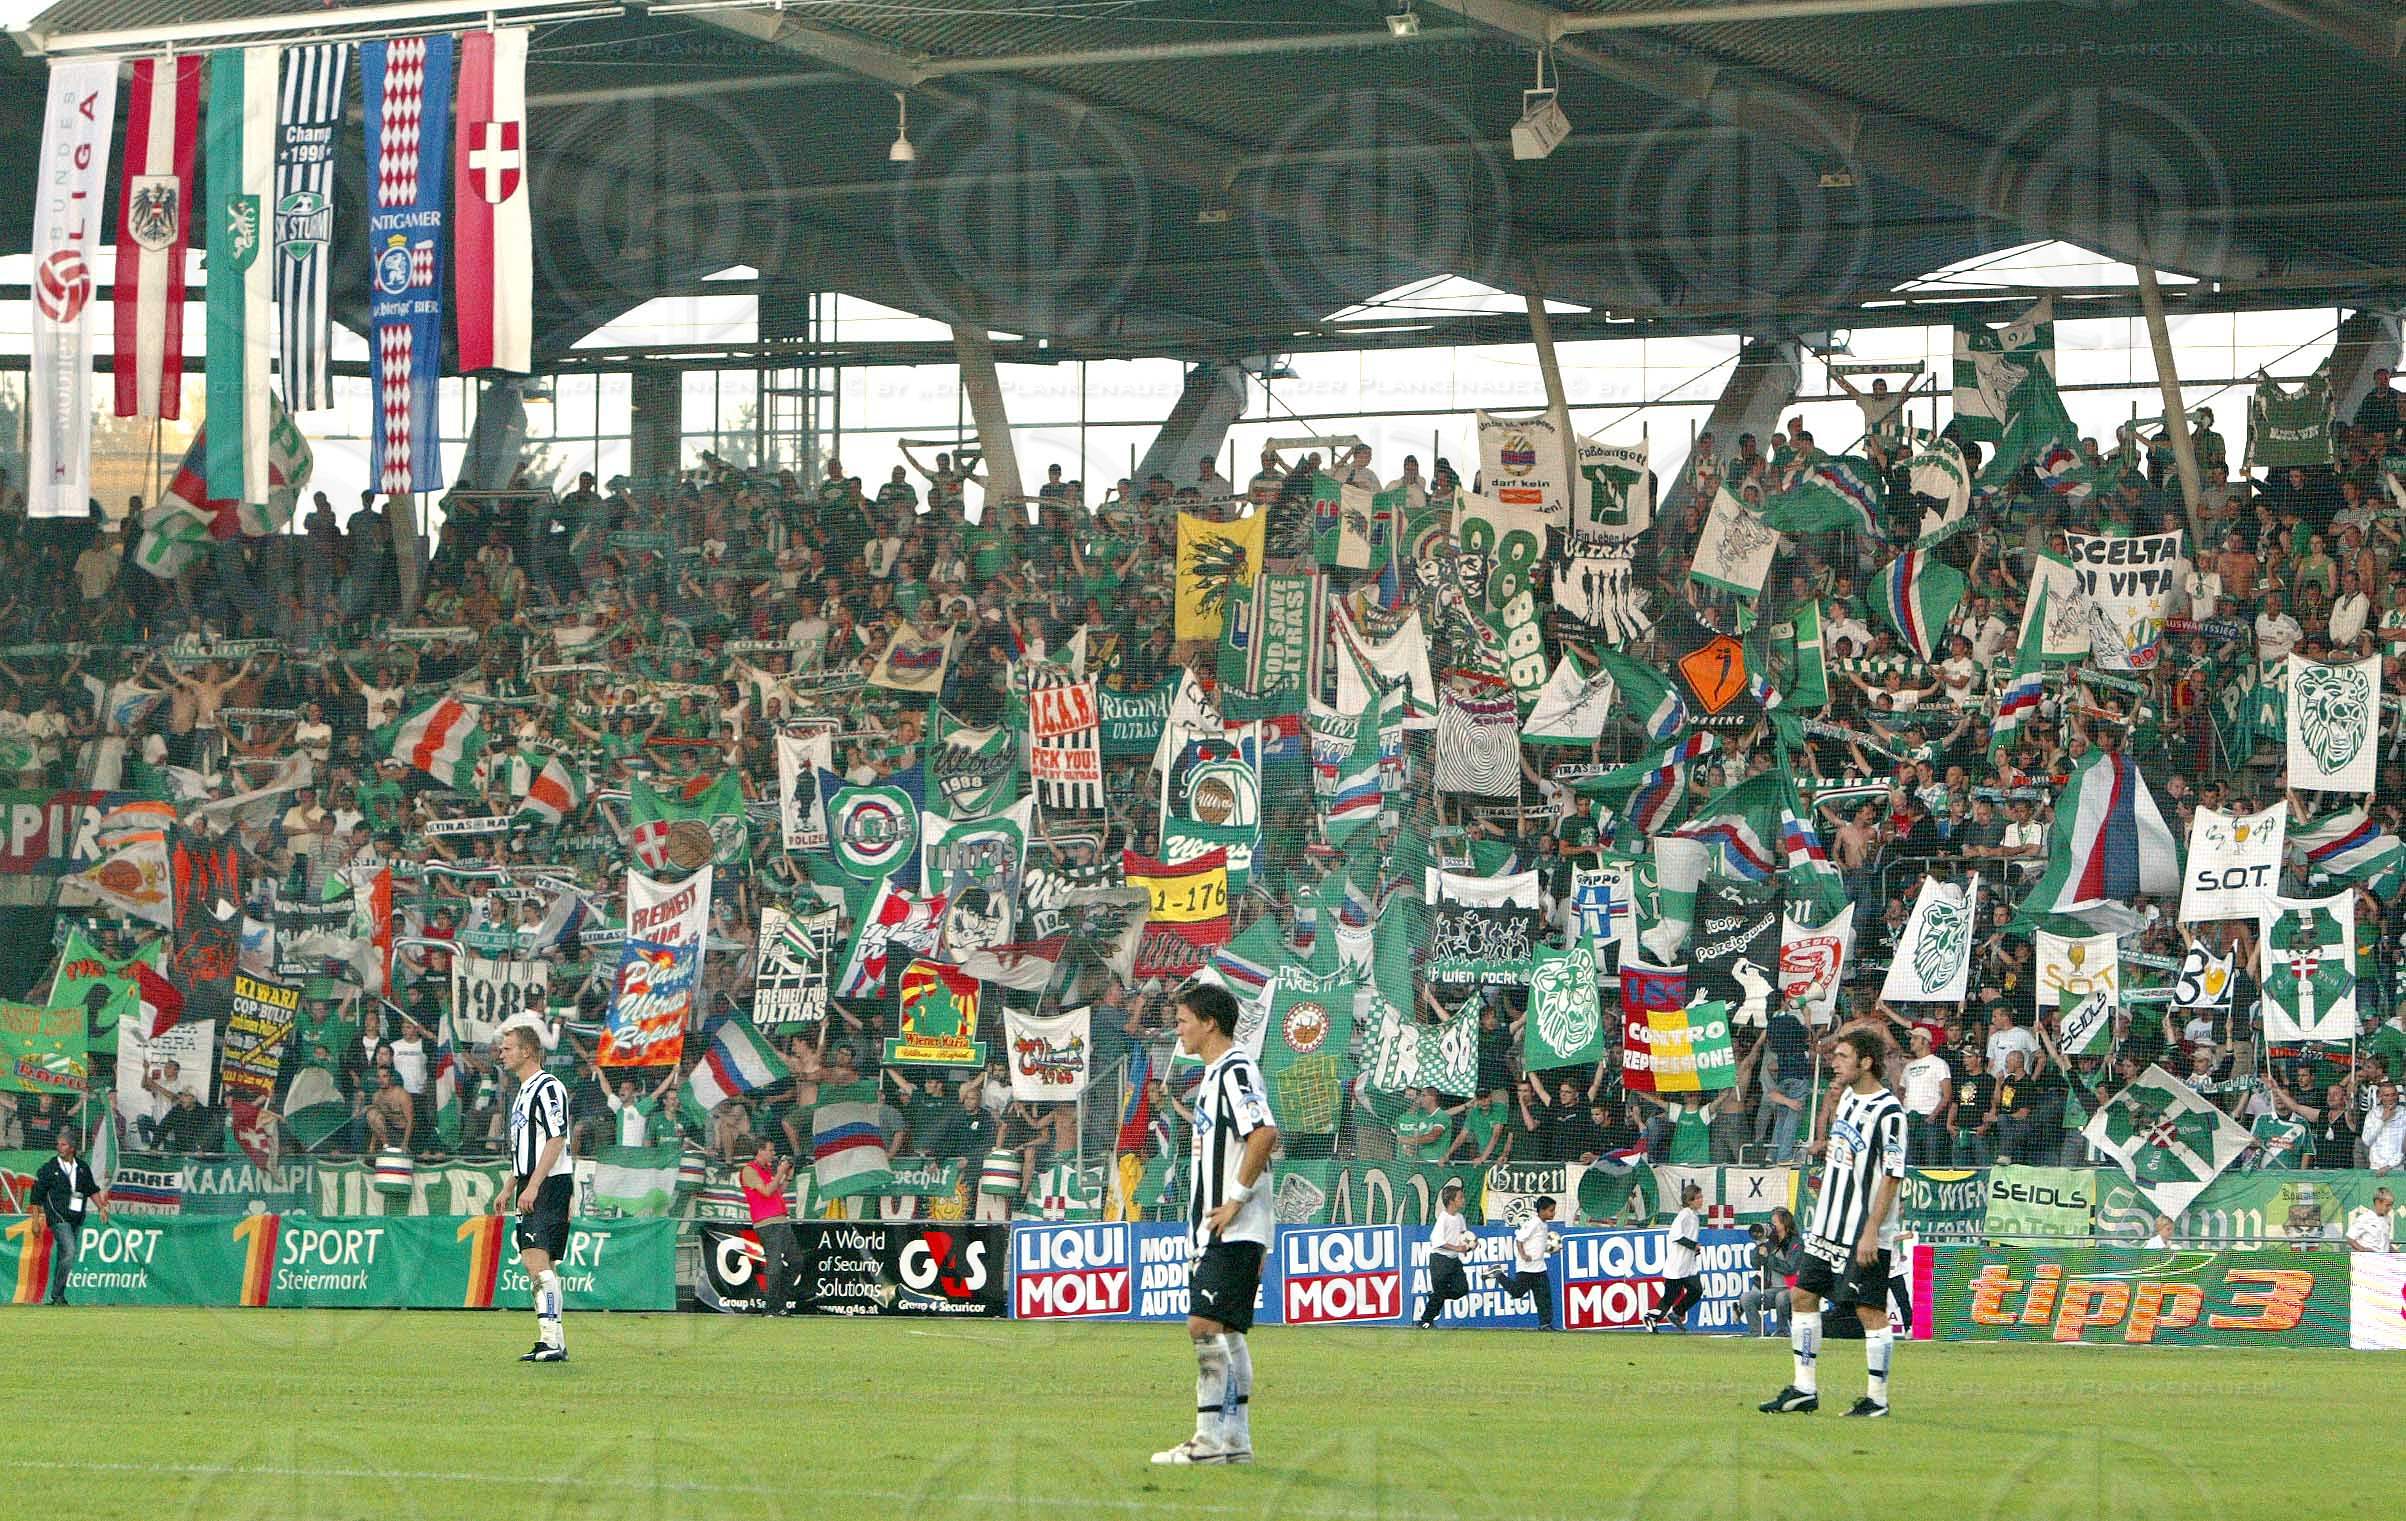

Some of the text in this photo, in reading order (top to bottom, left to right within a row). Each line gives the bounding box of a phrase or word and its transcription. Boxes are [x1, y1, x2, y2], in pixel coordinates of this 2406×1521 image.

[69, 90, 99, 240] LIGA
[369, 210, 441, 231] NTIGAMER
[2068, 535, 2177, 566] SCELTA
[2109, 569, 2174, 598] VITA
[1263, 579, 1288, 690] GOD SAVE
[1100, 684, 1175, 721] RIGINAL
[1113, 722, 1158, 739] ULTRAS
[1032, 750, 1059, 768] FCK
[1064, 749, 1098, 769] YOU!
[2195, 864, 2272, 892] S.O.T.
[1149, 880, 1227, 912] 1-176
[1442, 967, 1475, 984] wien
[1480, 969, 1518, 985] rockt
[755, 987, 807, 1005] FREIHEIT
[752, 1001, 827, 1025] ULTRAS
[1628, 1020, 1725, 1046] CONTRO
[1487, 1162, 1567, 1194] Green
[1991, 1179, 2088, 1210] SEIDLS
[78, 1227, 164, 1264] PORT
[282, 1228, 385, 1266] SPORT
[817, 1230, 886, 1251] A World
[1020, 1225, 1125, 1271] LIQUI
[1288, 1228, 1396, 1275] LIQUI
[65, 1267, 148, 1289] teiermark
[817, 1255, 885, 1277] of Security
[899, 1231, 988, 1298] G4S
[276, 1268, 370, 1291] Steiermark
[815, 1277, 882, 1298] Solutions
[1020, 1270, 1129, 1316] MOLY
[718, 1296, 749, 1309] Group
[897, 1300, 987, 1314] Group 4 Securicor
[1288, 1272, 1400, 1320] MOLY
[1969, 1263, 2317, 1344] tipp3
